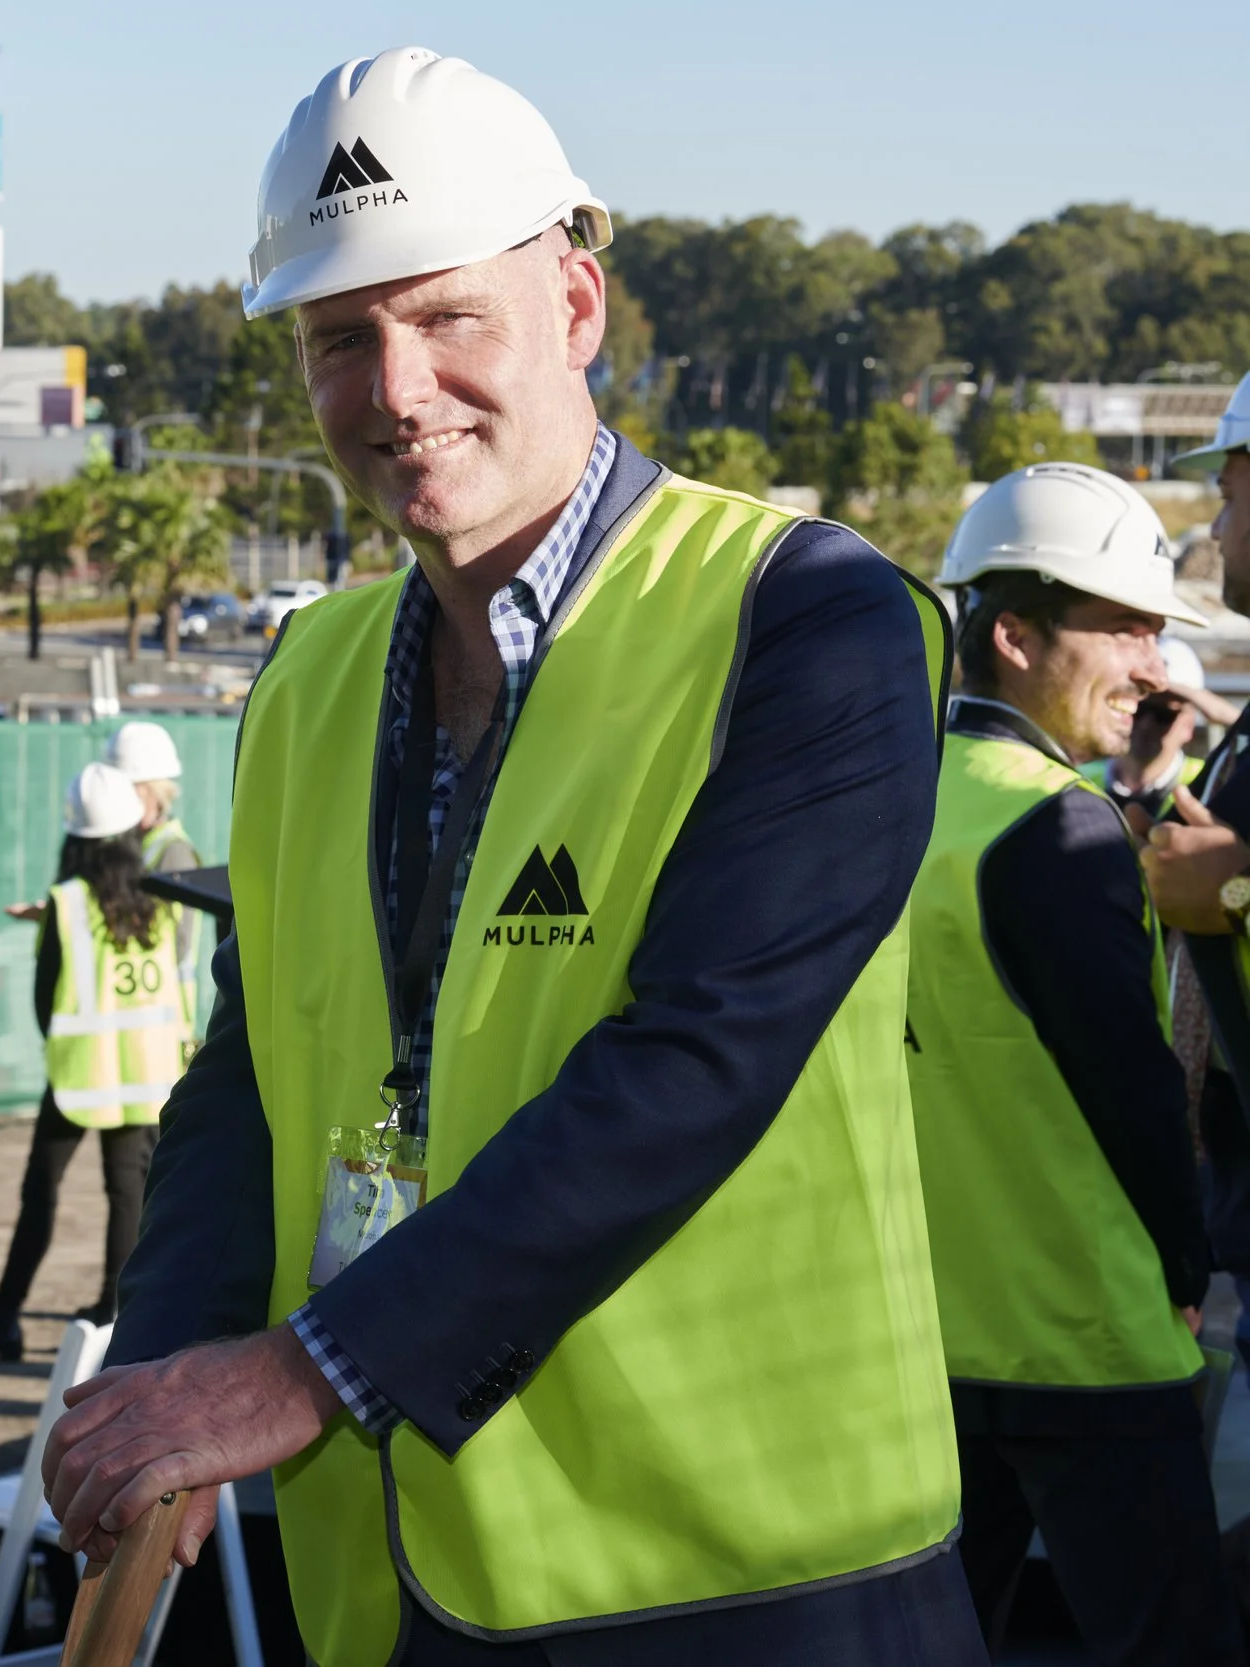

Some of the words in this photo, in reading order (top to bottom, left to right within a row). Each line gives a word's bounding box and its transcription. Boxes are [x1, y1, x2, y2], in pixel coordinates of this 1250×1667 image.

[309, 188, 409, 227] MULPHA
[482, 924, 595, 947] MULPHA
[114, 959, 161, 995] 30
[353, 1201, 392, 1219] Specer
